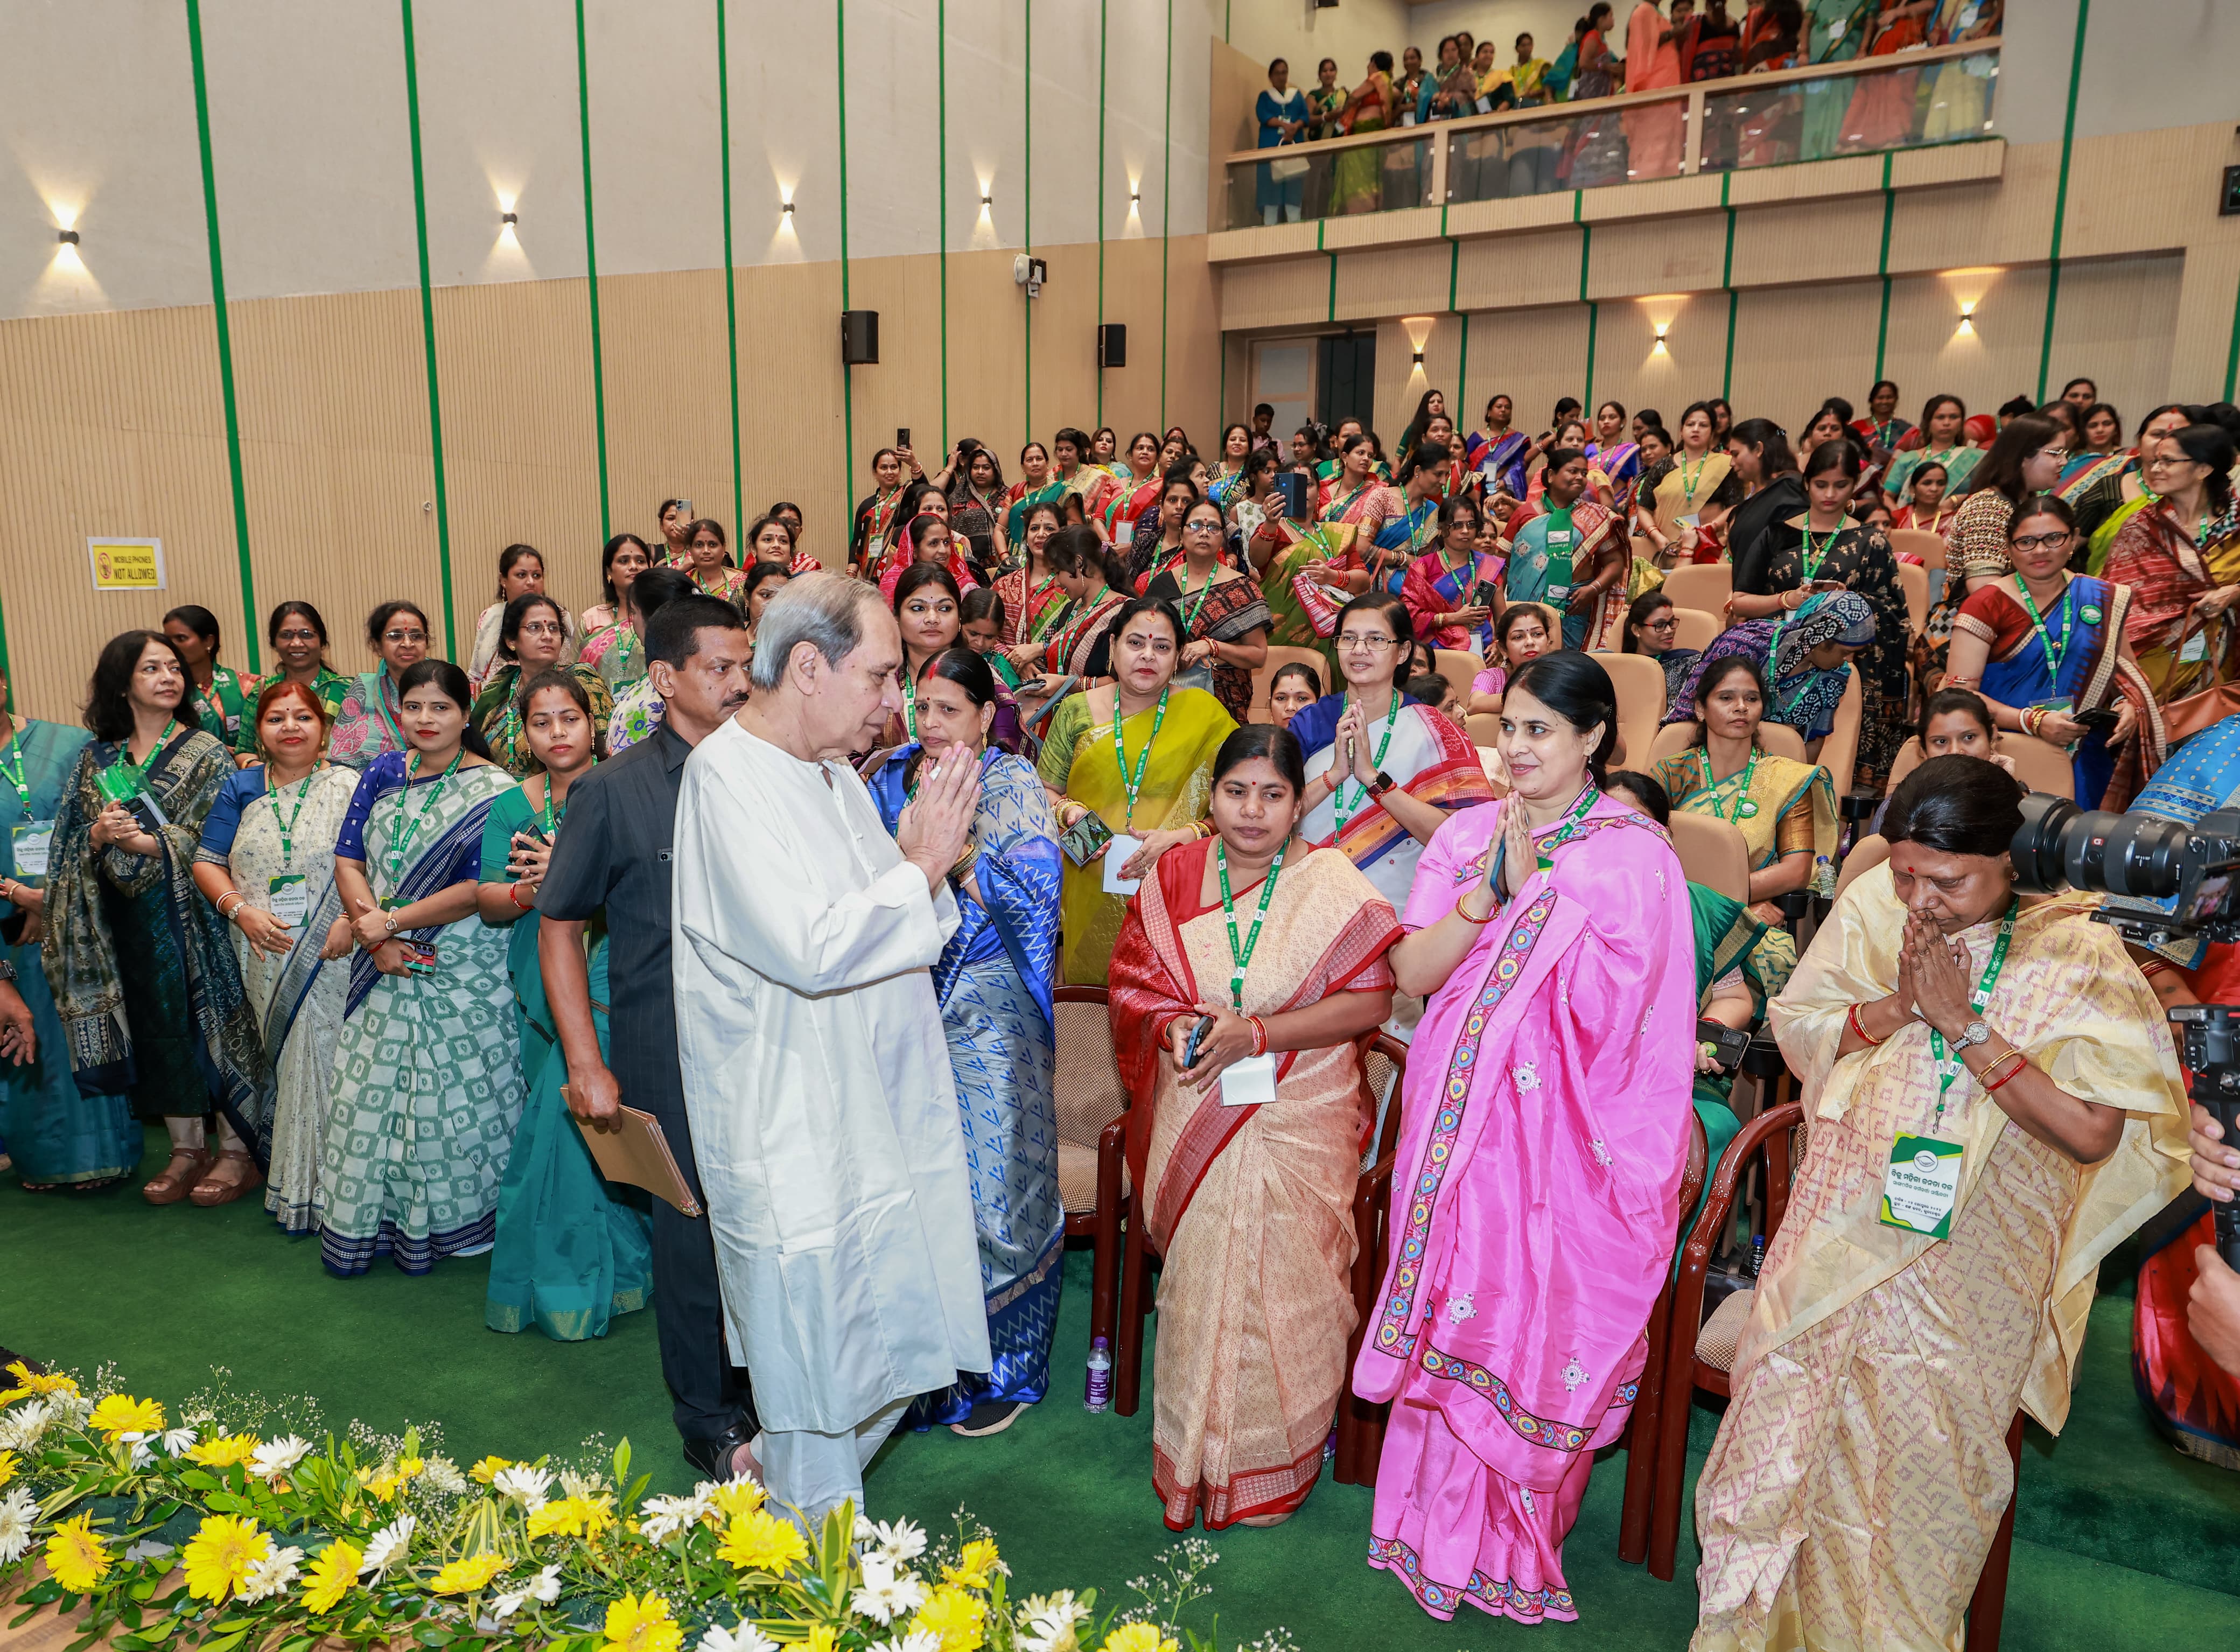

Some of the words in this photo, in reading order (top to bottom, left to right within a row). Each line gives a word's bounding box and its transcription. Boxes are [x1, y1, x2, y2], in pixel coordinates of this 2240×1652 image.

[114, 556, 131, 564] MOBILE
[132, 556, 151, 564] PHONES
[114, 569, 125, 579] NOT
[128, 569, 155, 579] ALLOWED
[1891, 1169, 1902, 1179] ବିଜୁ
[1903, 1173, 1921, 1183] ମହିଳା
[1922, 1178, 1940, 1188] ଜନତା
[1941, 1183, 1953, 1191] ଦଳ
